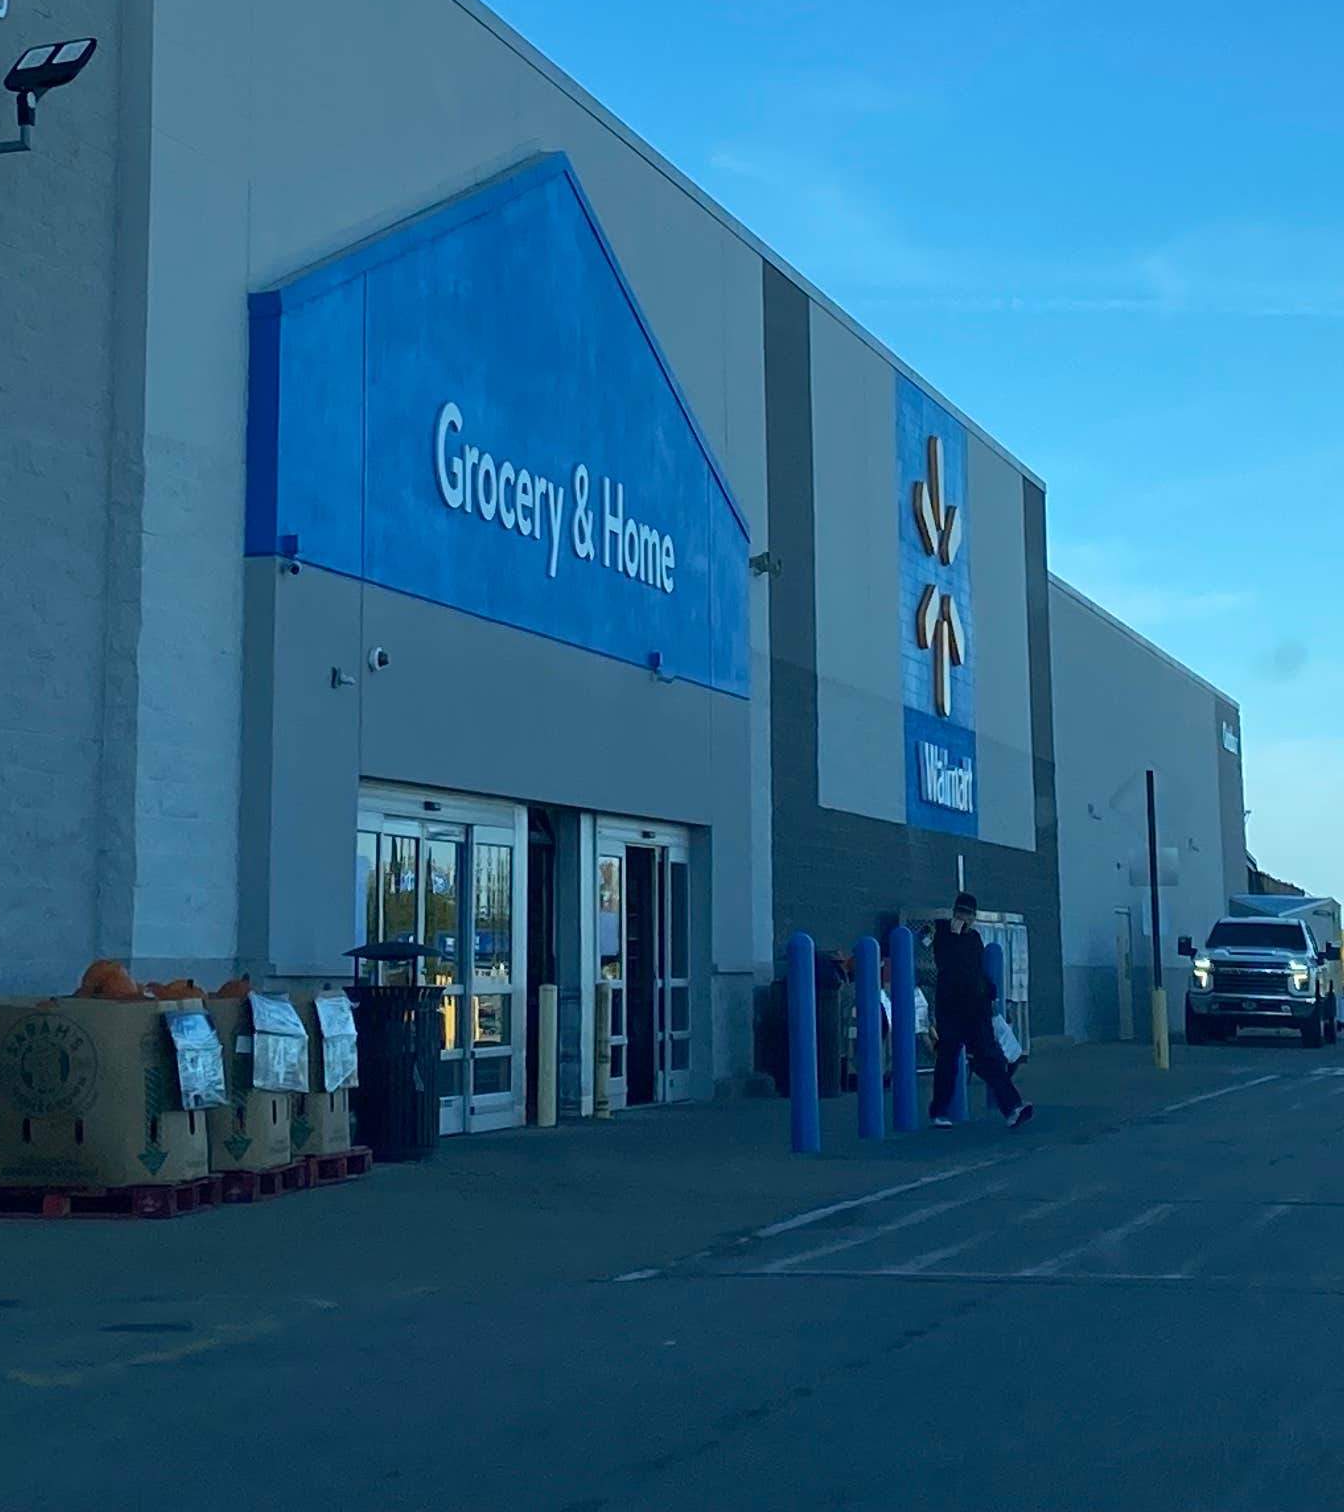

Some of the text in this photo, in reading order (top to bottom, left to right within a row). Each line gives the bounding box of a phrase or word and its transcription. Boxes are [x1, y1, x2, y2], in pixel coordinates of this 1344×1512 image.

[436, 401, 676, 593] Grocery & Home
[919, 740, 974, 814] Walmart
